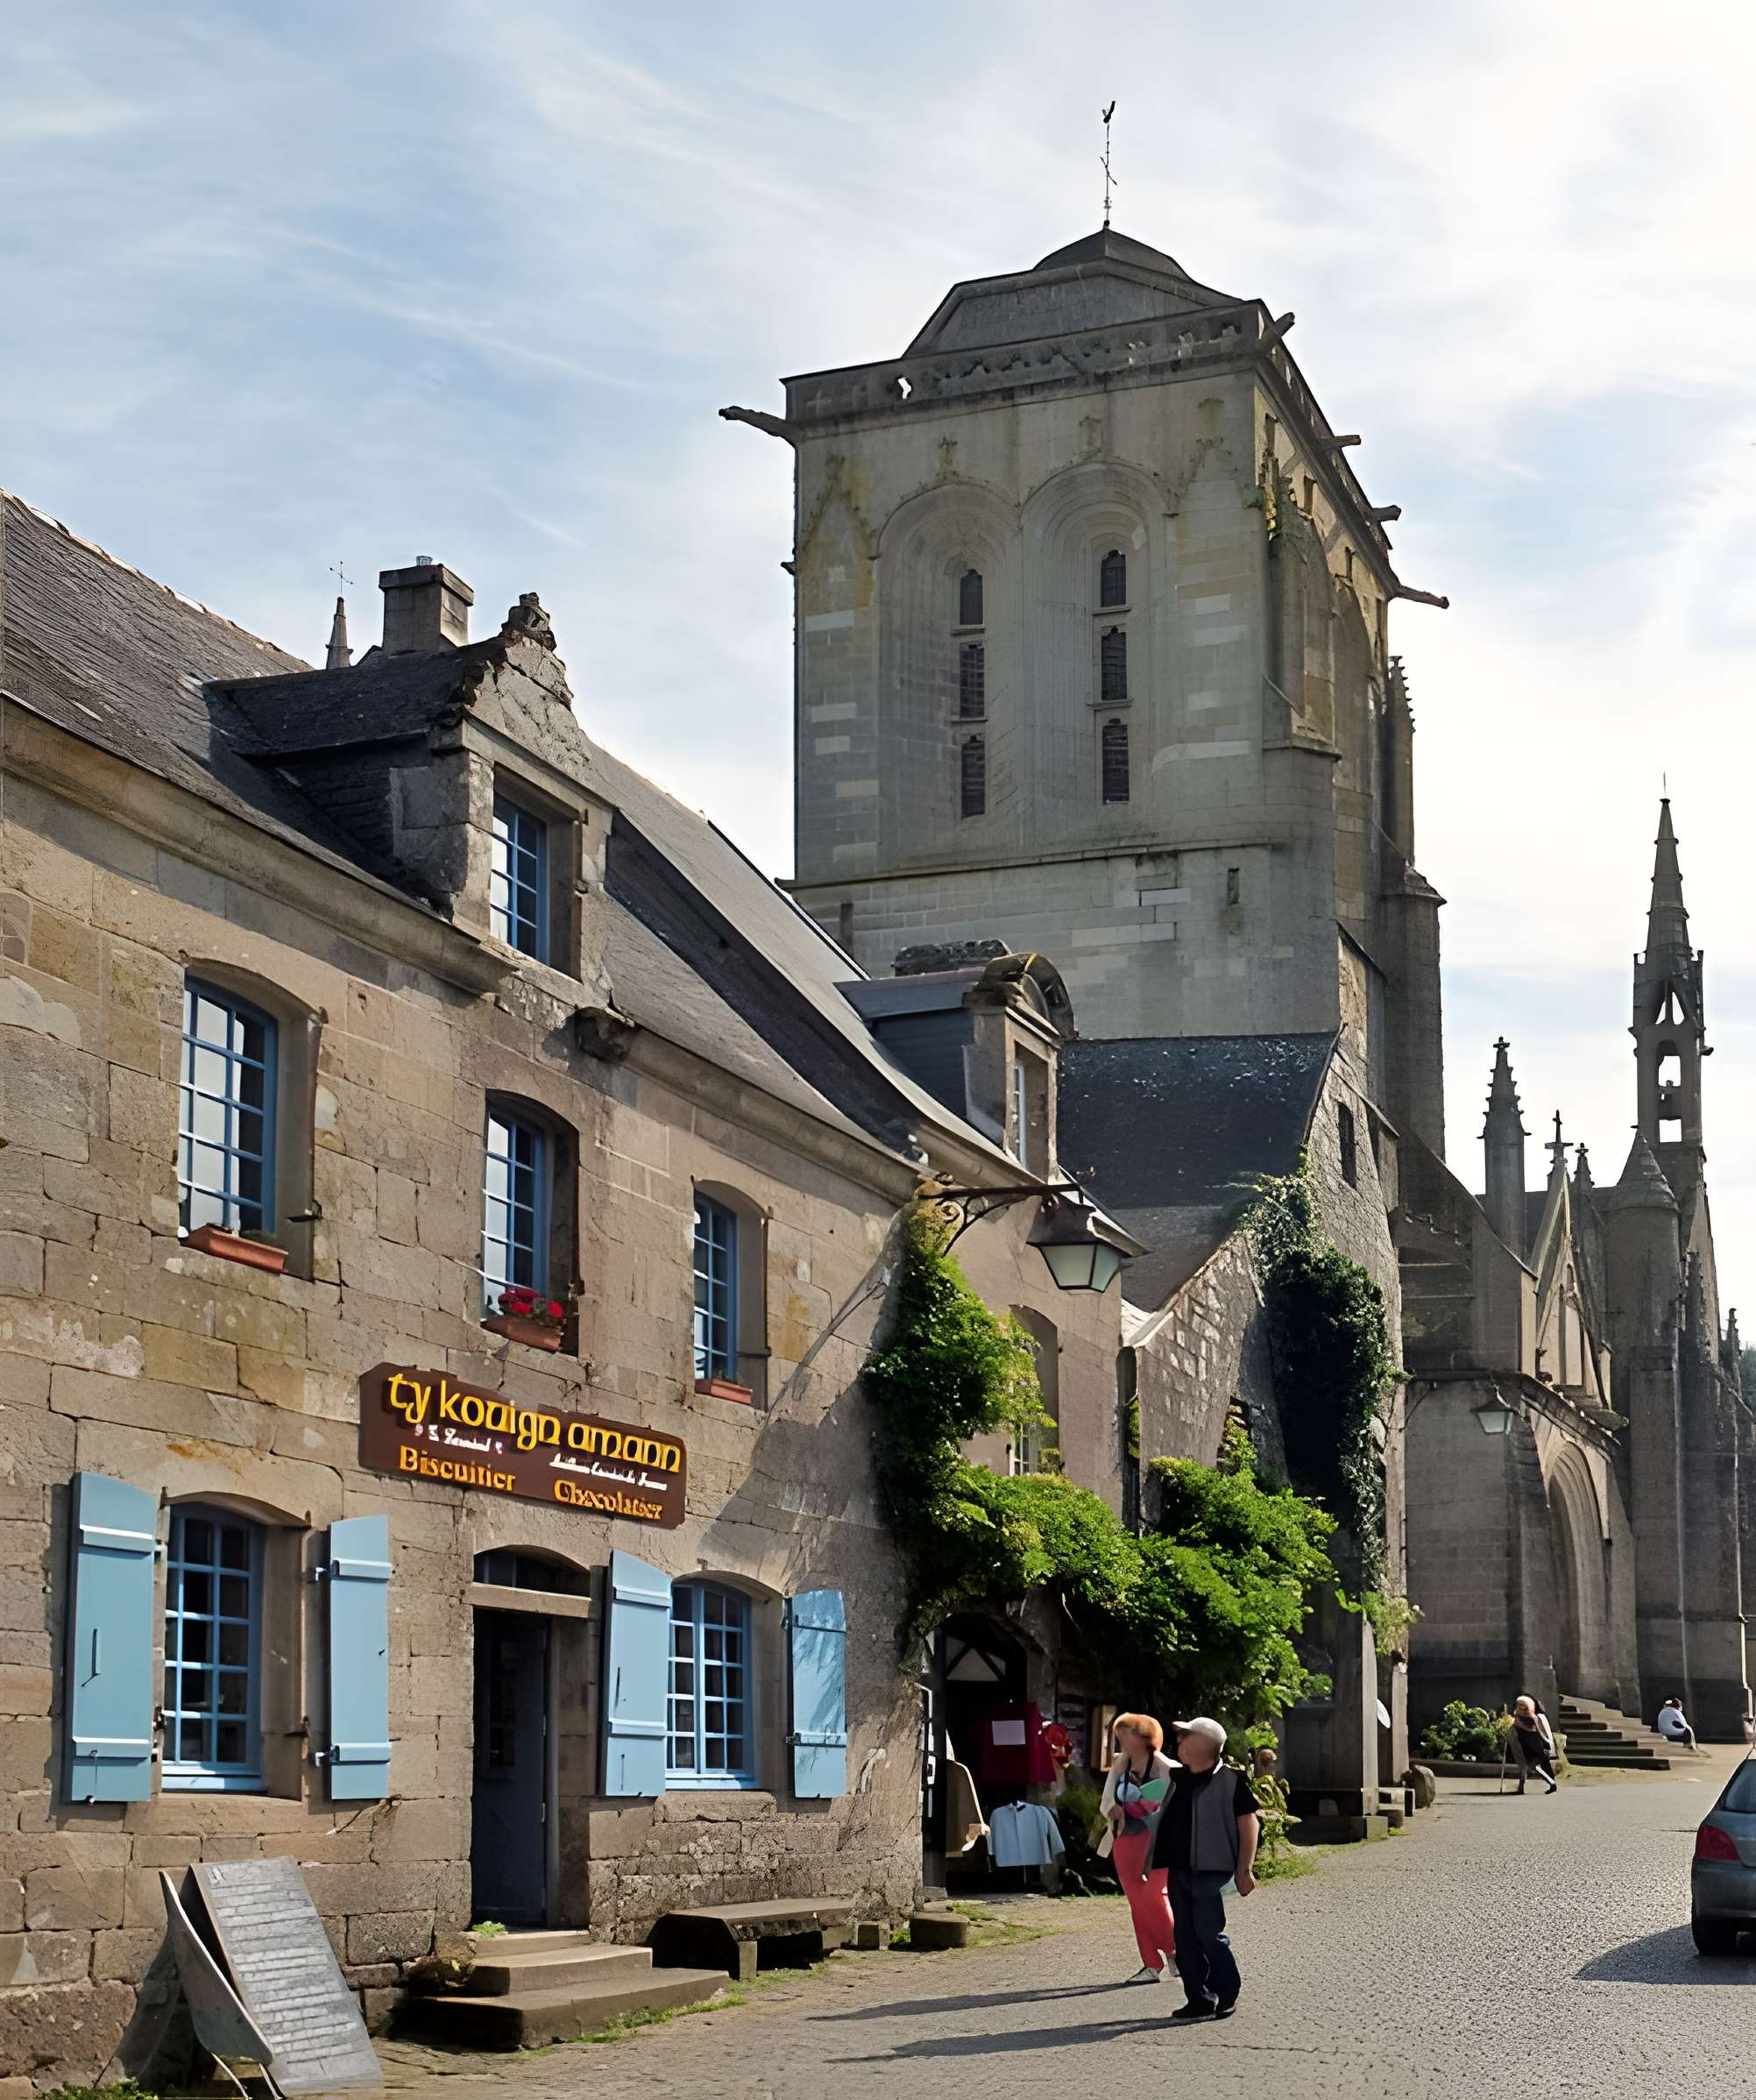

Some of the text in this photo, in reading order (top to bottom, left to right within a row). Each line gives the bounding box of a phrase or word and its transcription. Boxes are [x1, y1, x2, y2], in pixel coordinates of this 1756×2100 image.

[388, 1373, 432, 1424] ty
[567, 1422, 681, 1473] amann
[400, 1444, 516, 1492] Biscuitier
